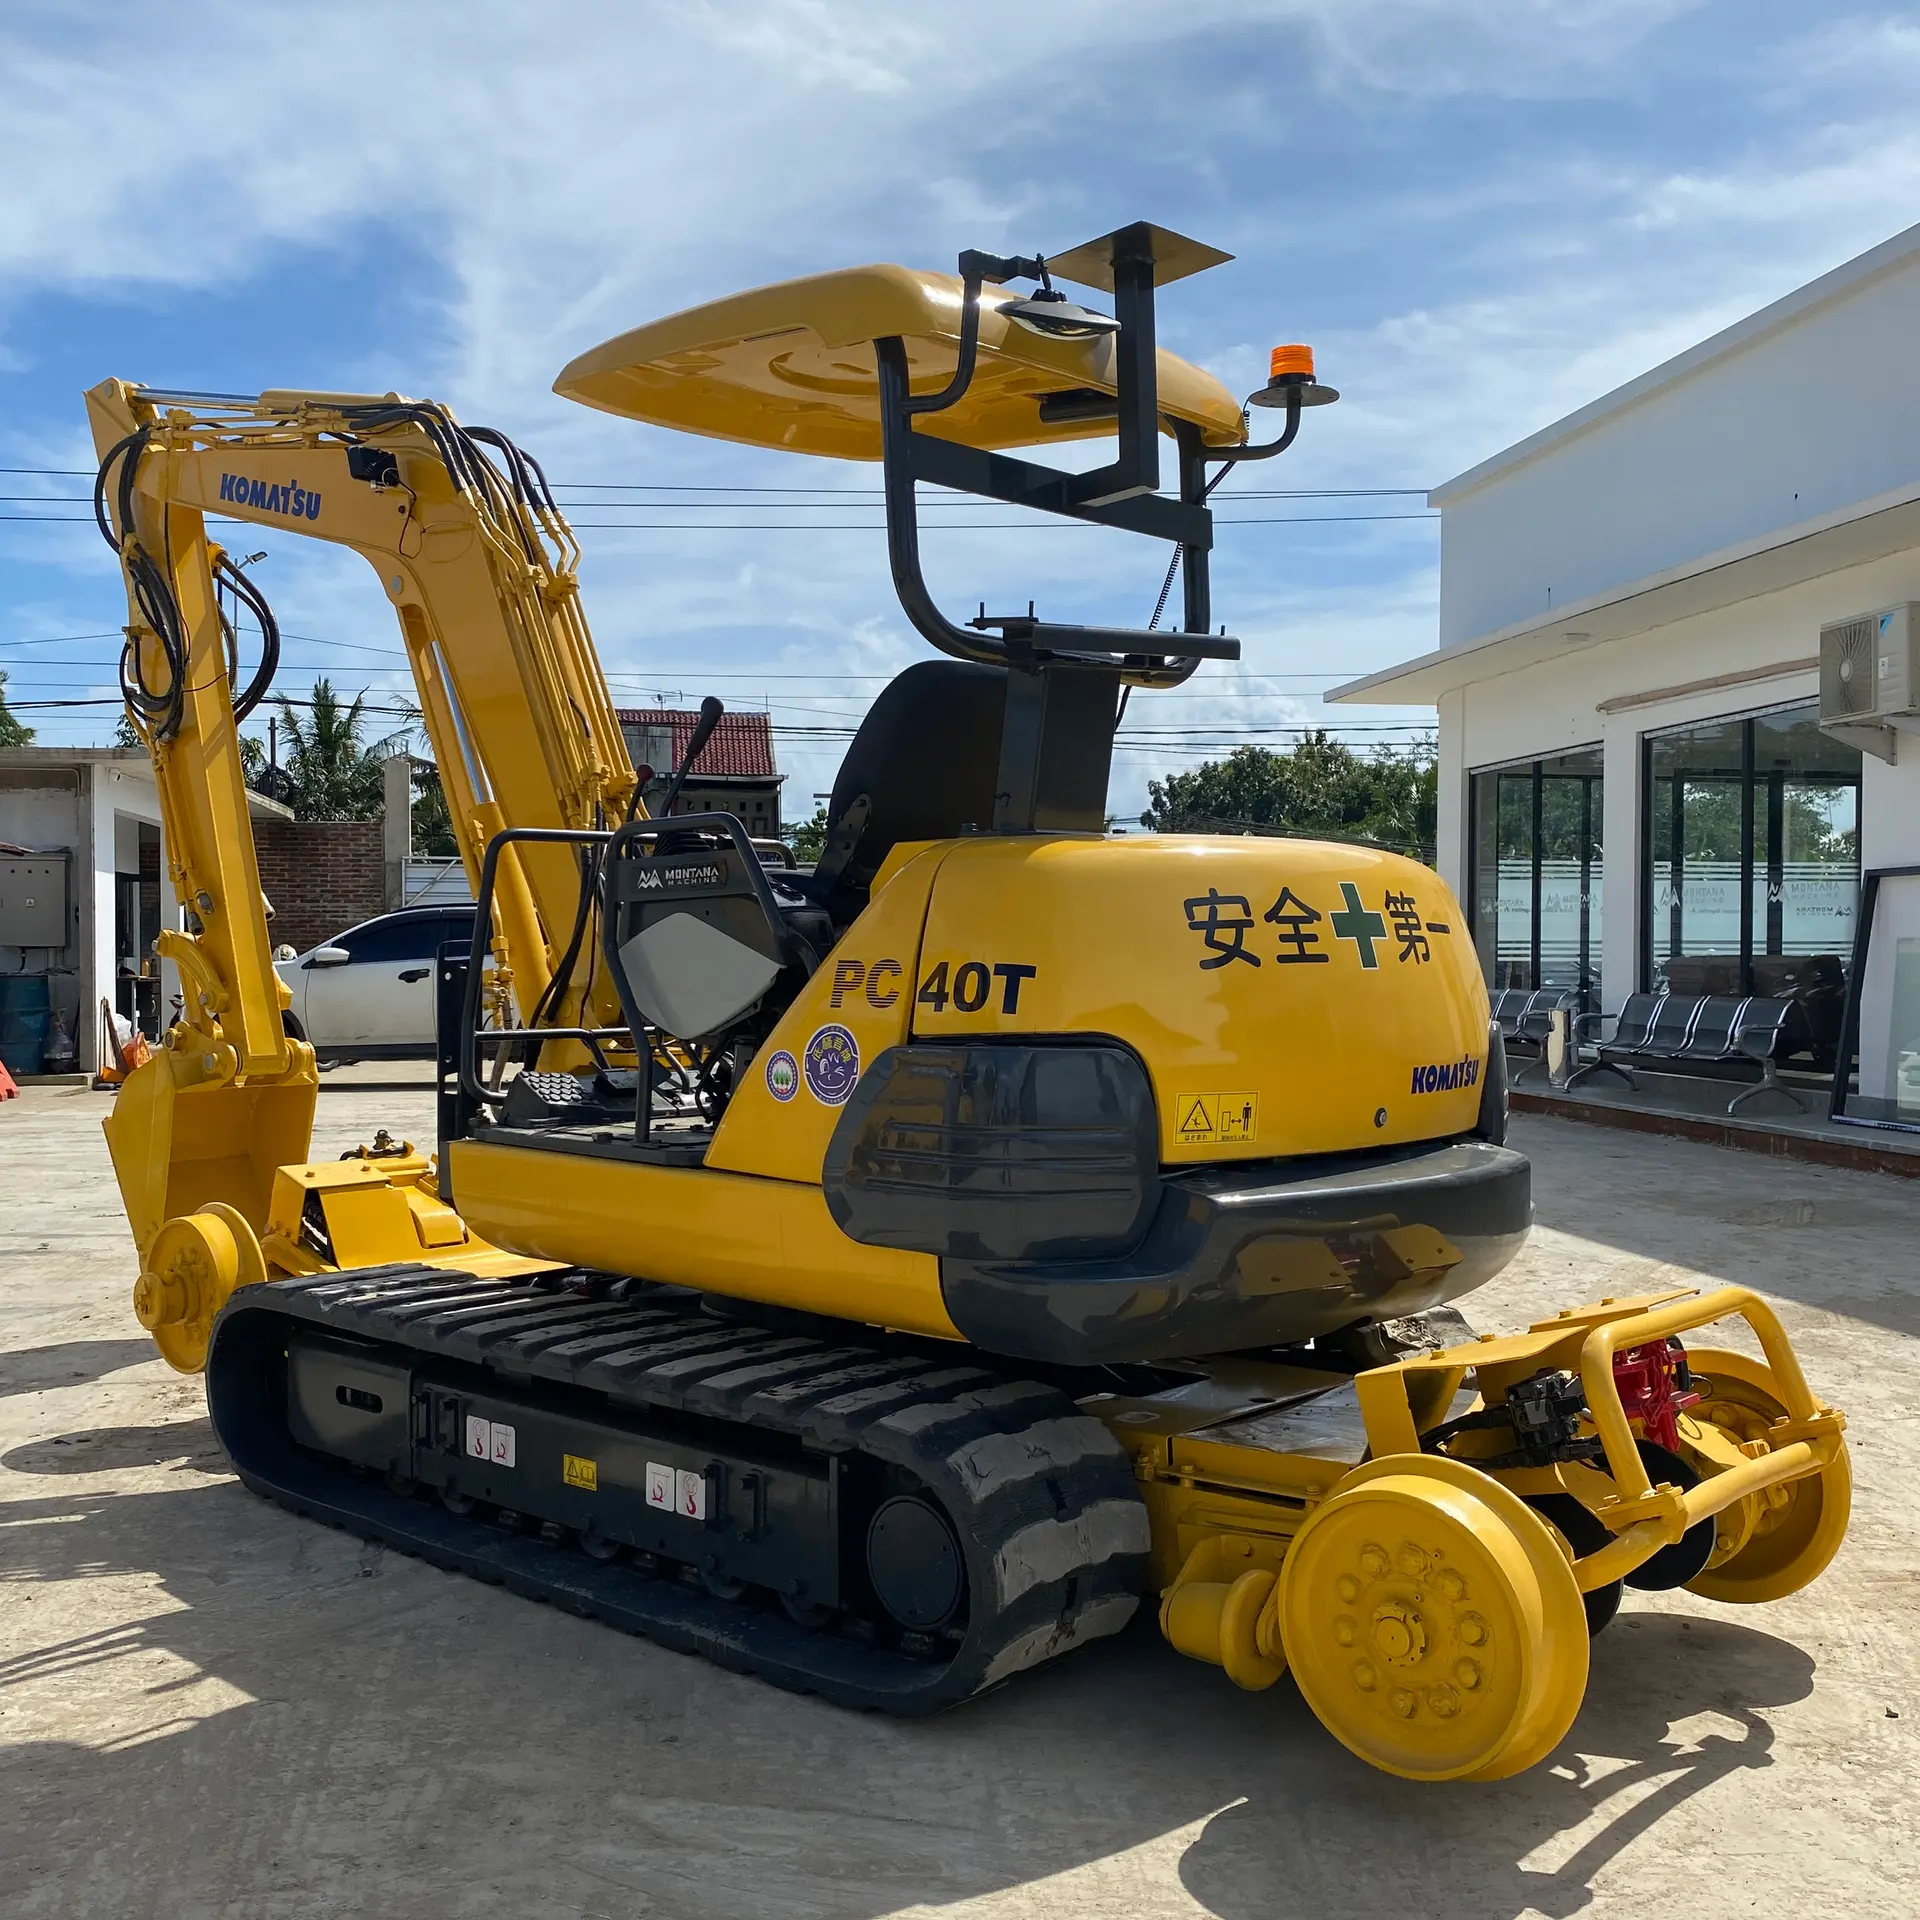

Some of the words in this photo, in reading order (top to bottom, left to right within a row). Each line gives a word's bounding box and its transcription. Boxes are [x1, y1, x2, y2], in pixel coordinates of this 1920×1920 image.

[220, 473, 322, 520] KOMATSU
[665, 866, 719, 880] MONTANA
[667, 875, 718, 886] MACHINE
[1184, 888, 1329, 970] 安全
[1384, 889, 1450, 965] 第一
[830, 959, 902, 1008] PC
[917, 961, 1037, 1015] 40T
[1411, 1053, 1479, 1094] KOMATSU
